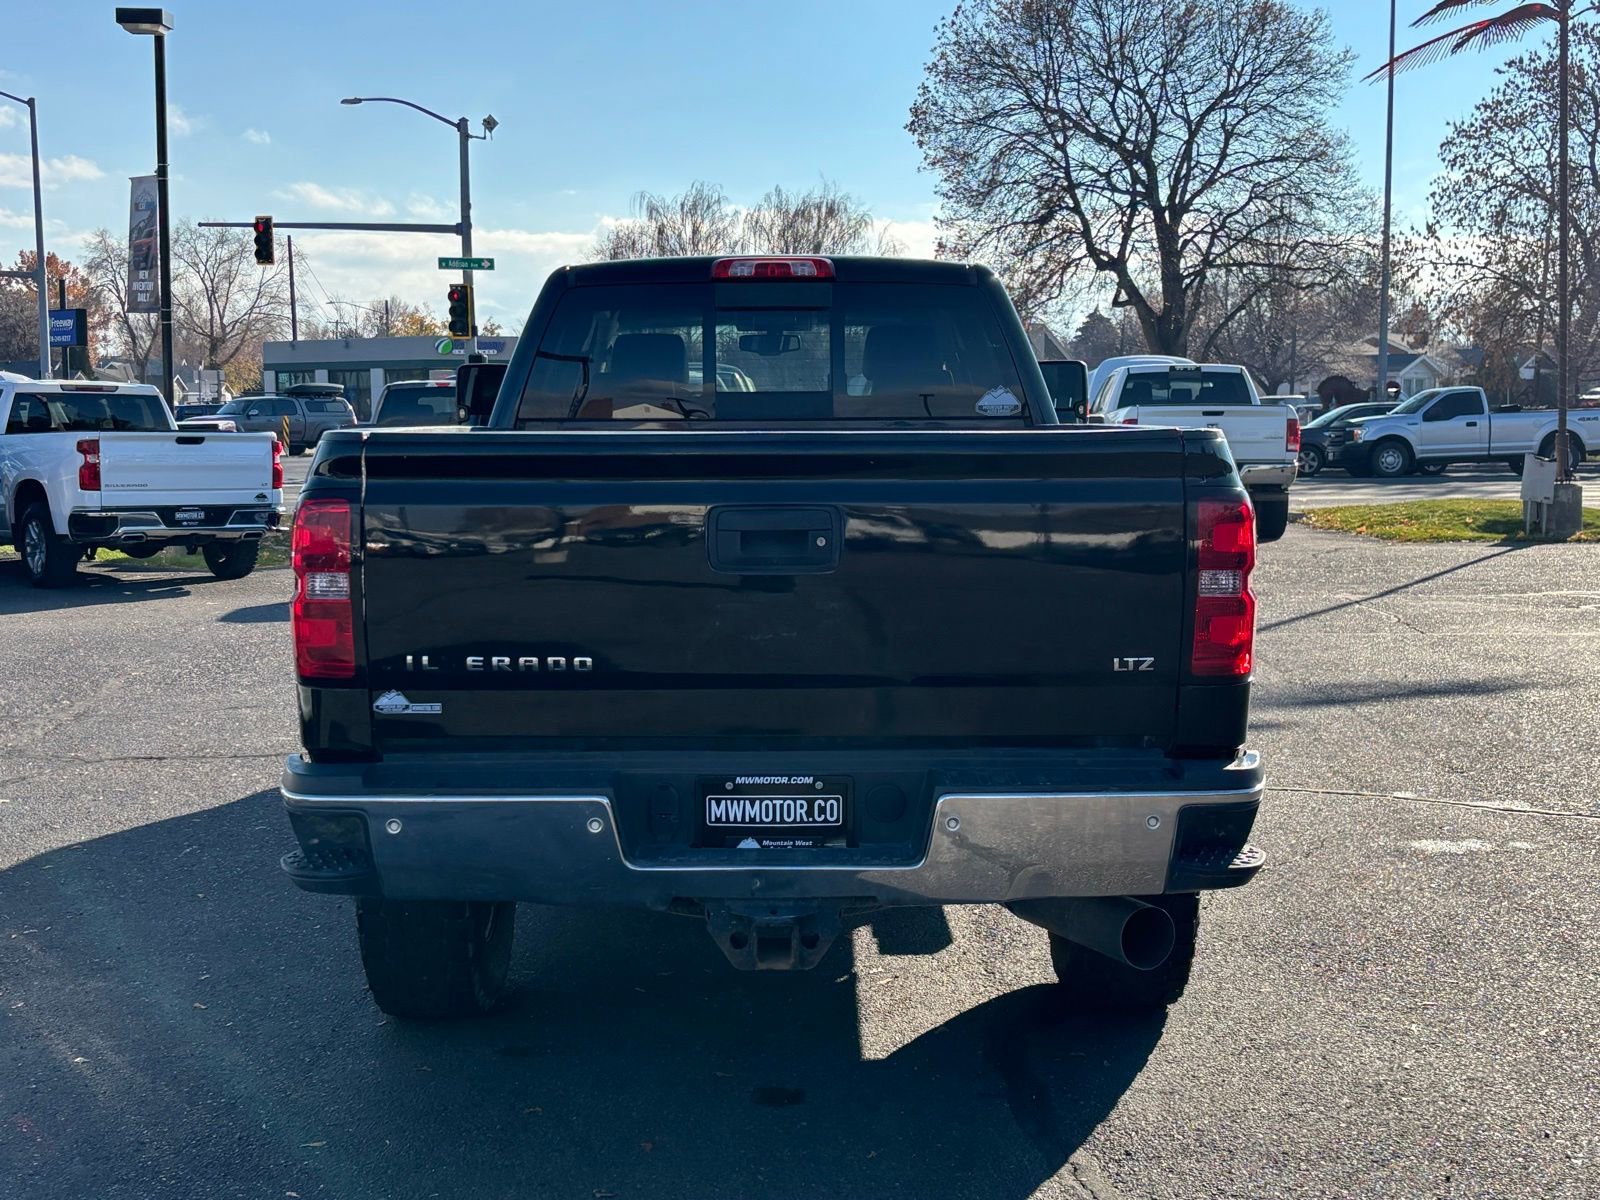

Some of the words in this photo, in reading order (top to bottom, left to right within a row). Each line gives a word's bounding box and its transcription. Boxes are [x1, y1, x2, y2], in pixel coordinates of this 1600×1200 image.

[137, 292, 150, 302] DAILY
[51, 317, 74, 329] Freeway
[1113, 656, 1155, 671] LTZ
[735, 776, 814, 785] MWMOTOR.COM
[710, 799, 839, 822] MWMOTOR.CO
